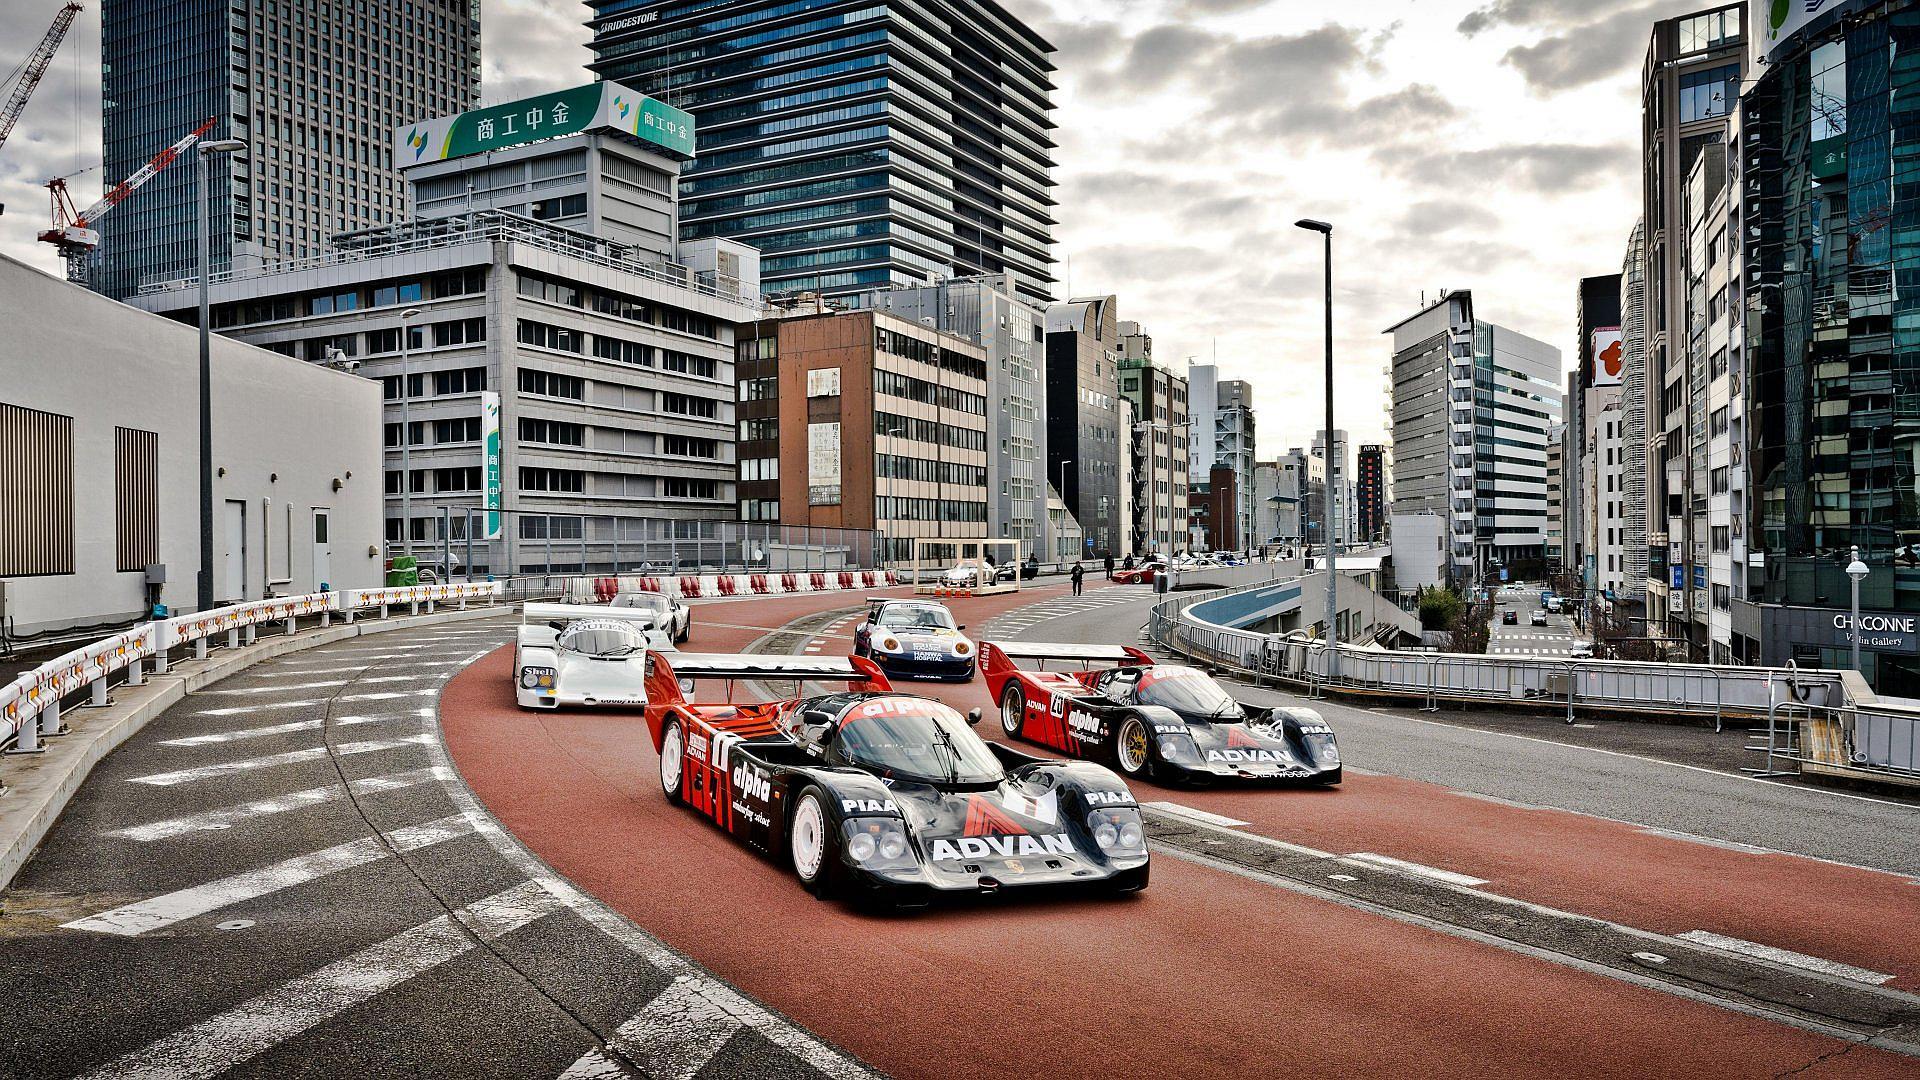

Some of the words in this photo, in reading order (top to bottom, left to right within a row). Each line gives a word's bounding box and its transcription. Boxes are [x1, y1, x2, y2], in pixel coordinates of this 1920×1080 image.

[600, 10, 658, 34] BRIDGESTONE
[477, 101, 570, 142] 商工中金
[643, 111, 688, 139] 商工中金
[1846, 633, 1869, 645] Vlin
[1871, 637, 1902, 646] Gallery
[524, 667, 553, 676] Shell
[863, 697, 943, 717] alph
[1025, 699, 1046, 713] ADVAN
[1068, 710, 1100, 733] alpha
[1155, 725, 1190, 734] PIAA
[1300, 726, 1333, 734] PIAA
[1208, 750, 1294, 762] ADVAN
[733, 761, 771, 803] alpha
[841, 798, 900, 813] PIAA
[1084, 791, 1134, 806] PIAA
[932, 833, 1076, 861] ADVAN
